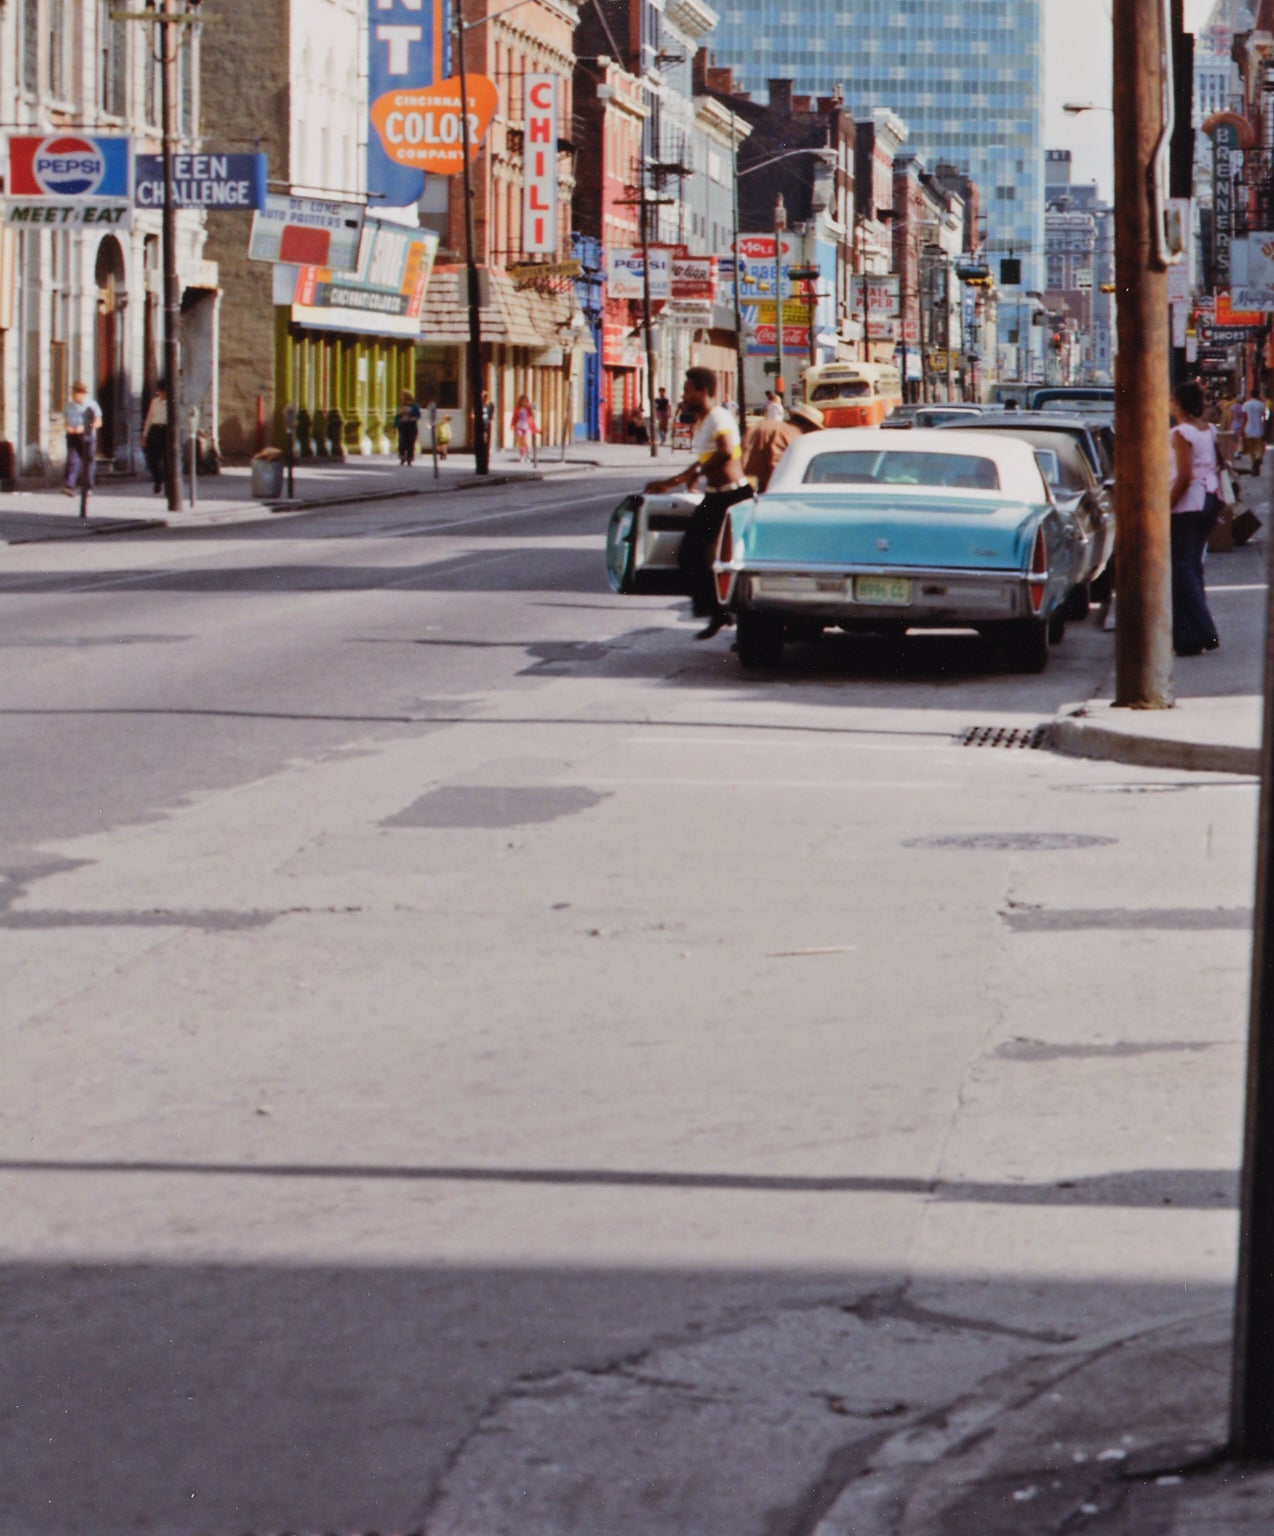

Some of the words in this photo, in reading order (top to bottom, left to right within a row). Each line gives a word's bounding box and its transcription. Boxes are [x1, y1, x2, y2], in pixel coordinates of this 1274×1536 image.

[394, 95, 476, 107] CINCINNAI
[385, 111, 480, 145] COLOR
[36, 159, 101, 175] PEPSI
[156, 155, 228, 180] EEN
[529, 82, 553, 245] CHILI
[137, 180, 250, 205] CHALLENGE
[290, 212, 341, 228] PAINTERS
[856, 297, 893, 308] PPER
